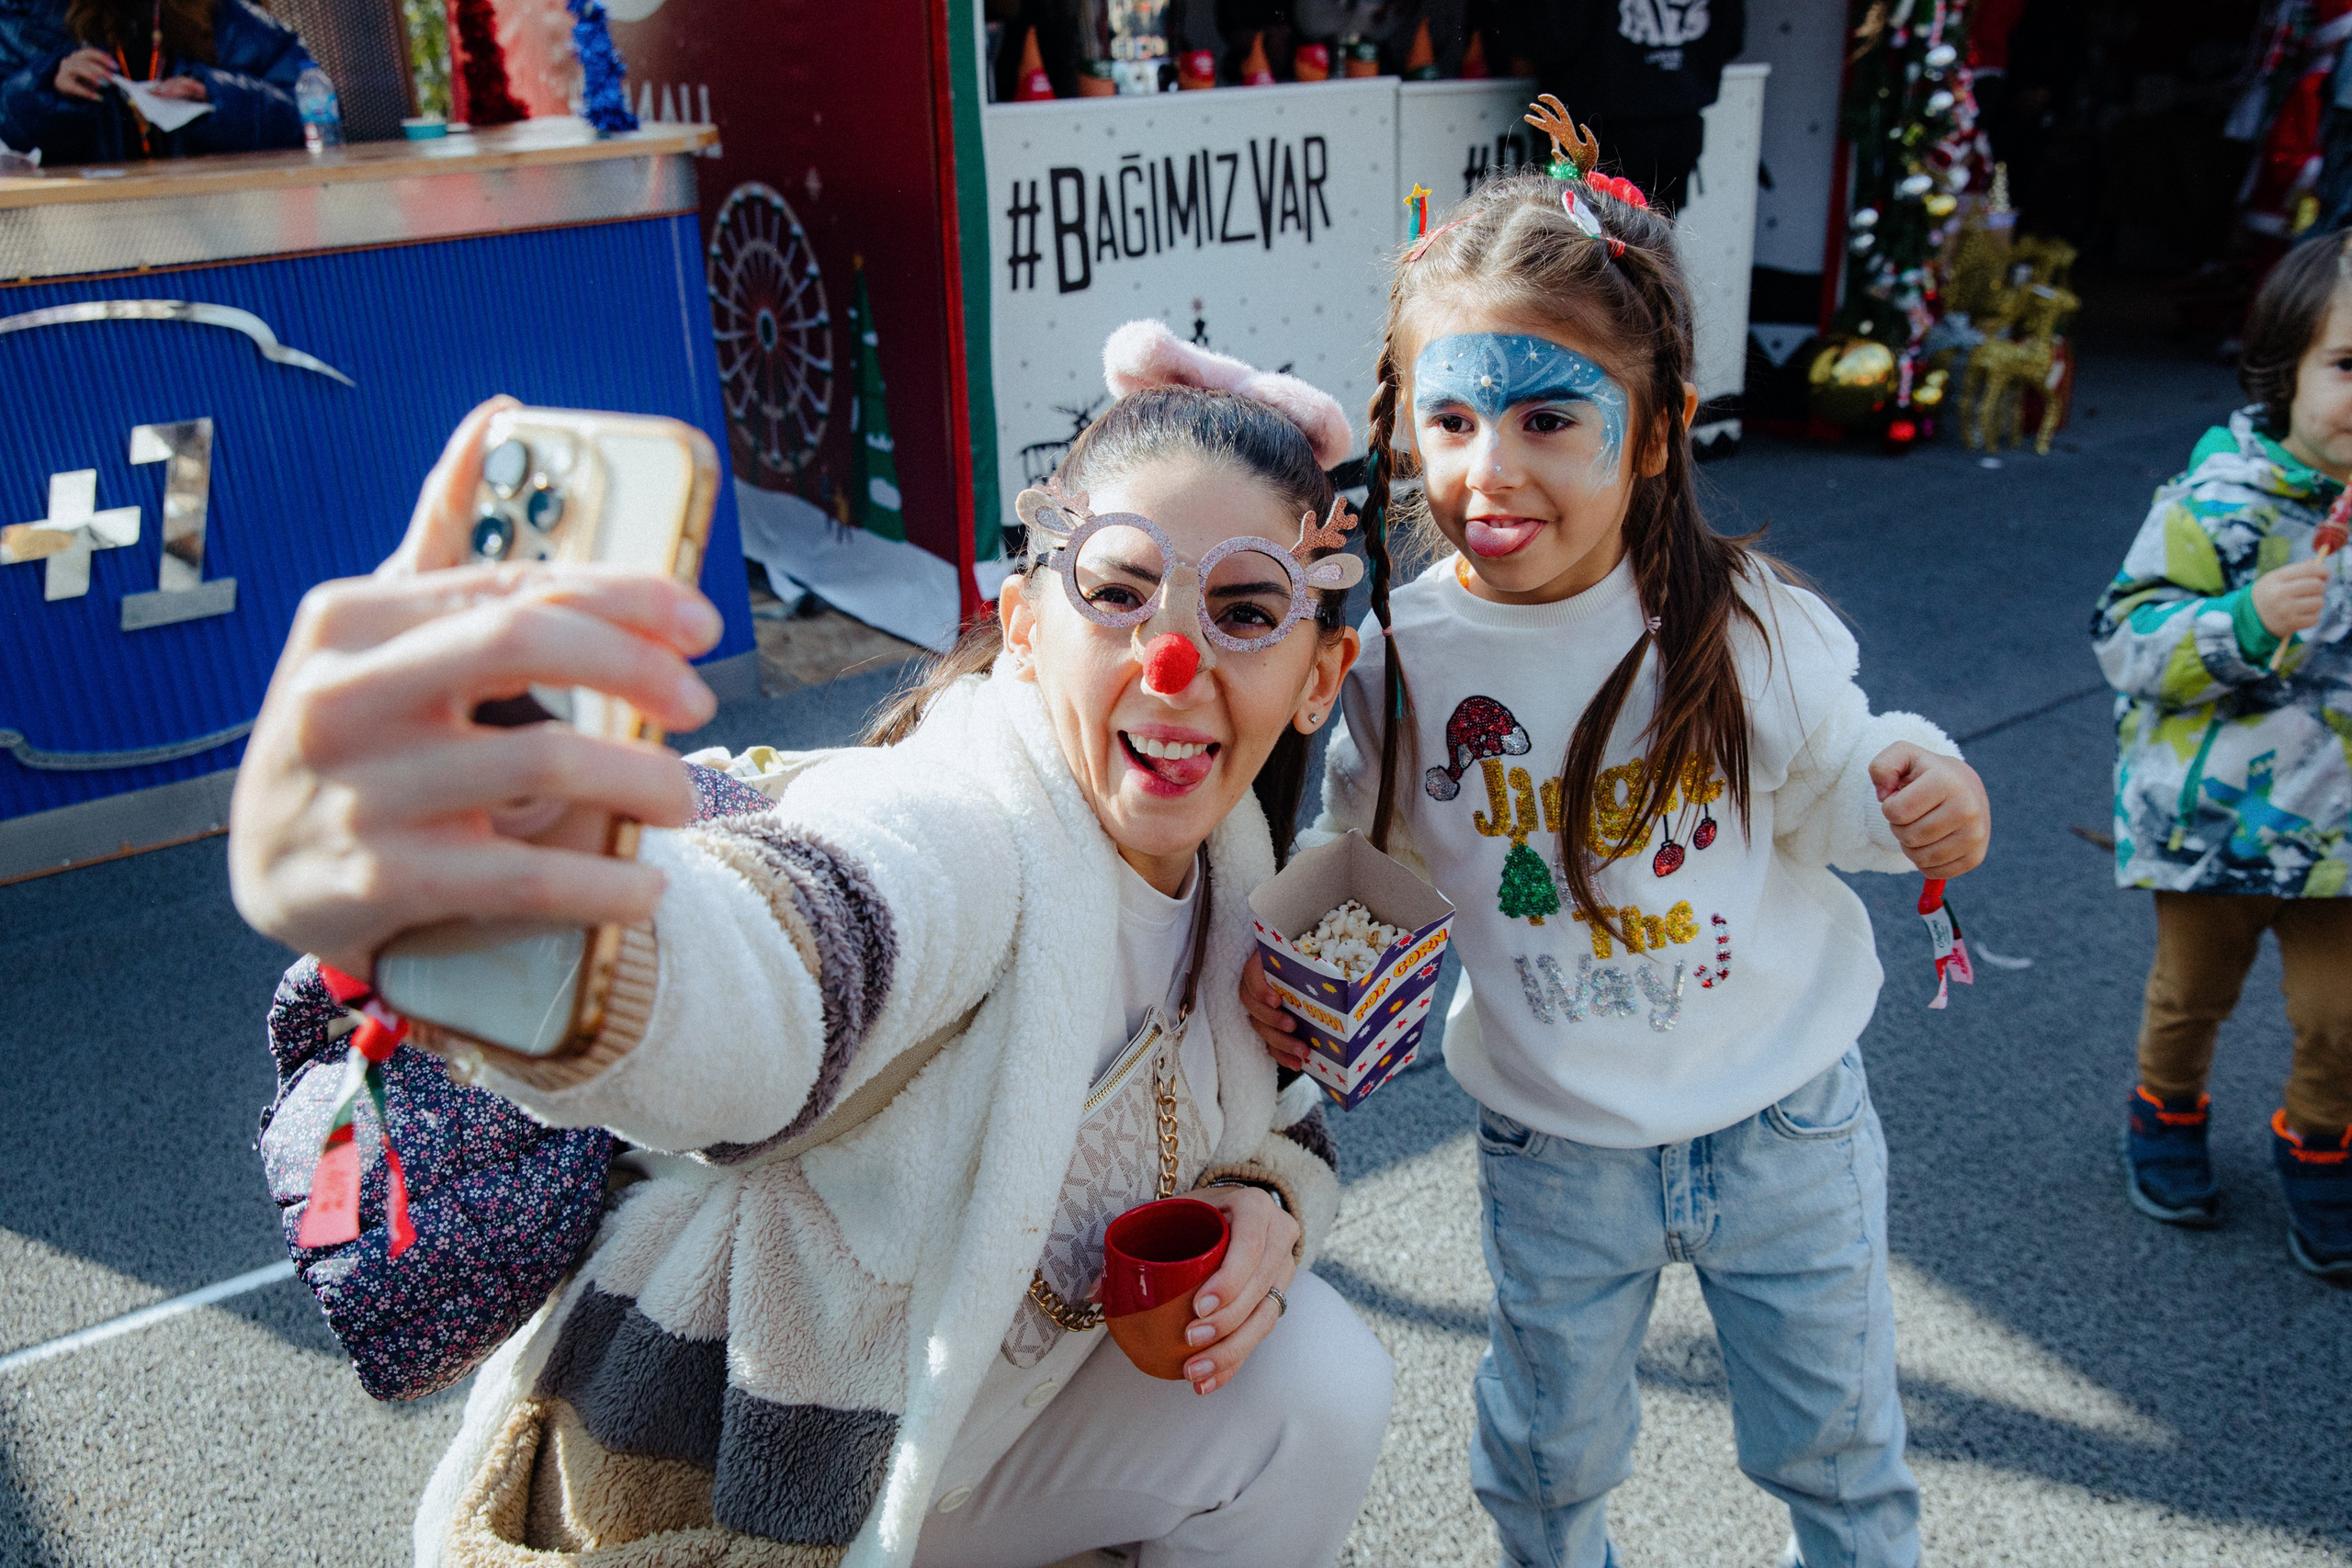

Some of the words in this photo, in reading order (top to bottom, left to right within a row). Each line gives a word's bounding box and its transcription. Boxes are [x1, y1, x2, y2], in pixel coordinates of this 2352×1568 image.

[1572, 900, 1700, 960] The
[1352, 977, 1391, 1022] POP
[1393, 928, 1448, 978] CORN
[1512, 953, 1687, 1032] Way
[1302, 999, 1346, 1034] CORN
